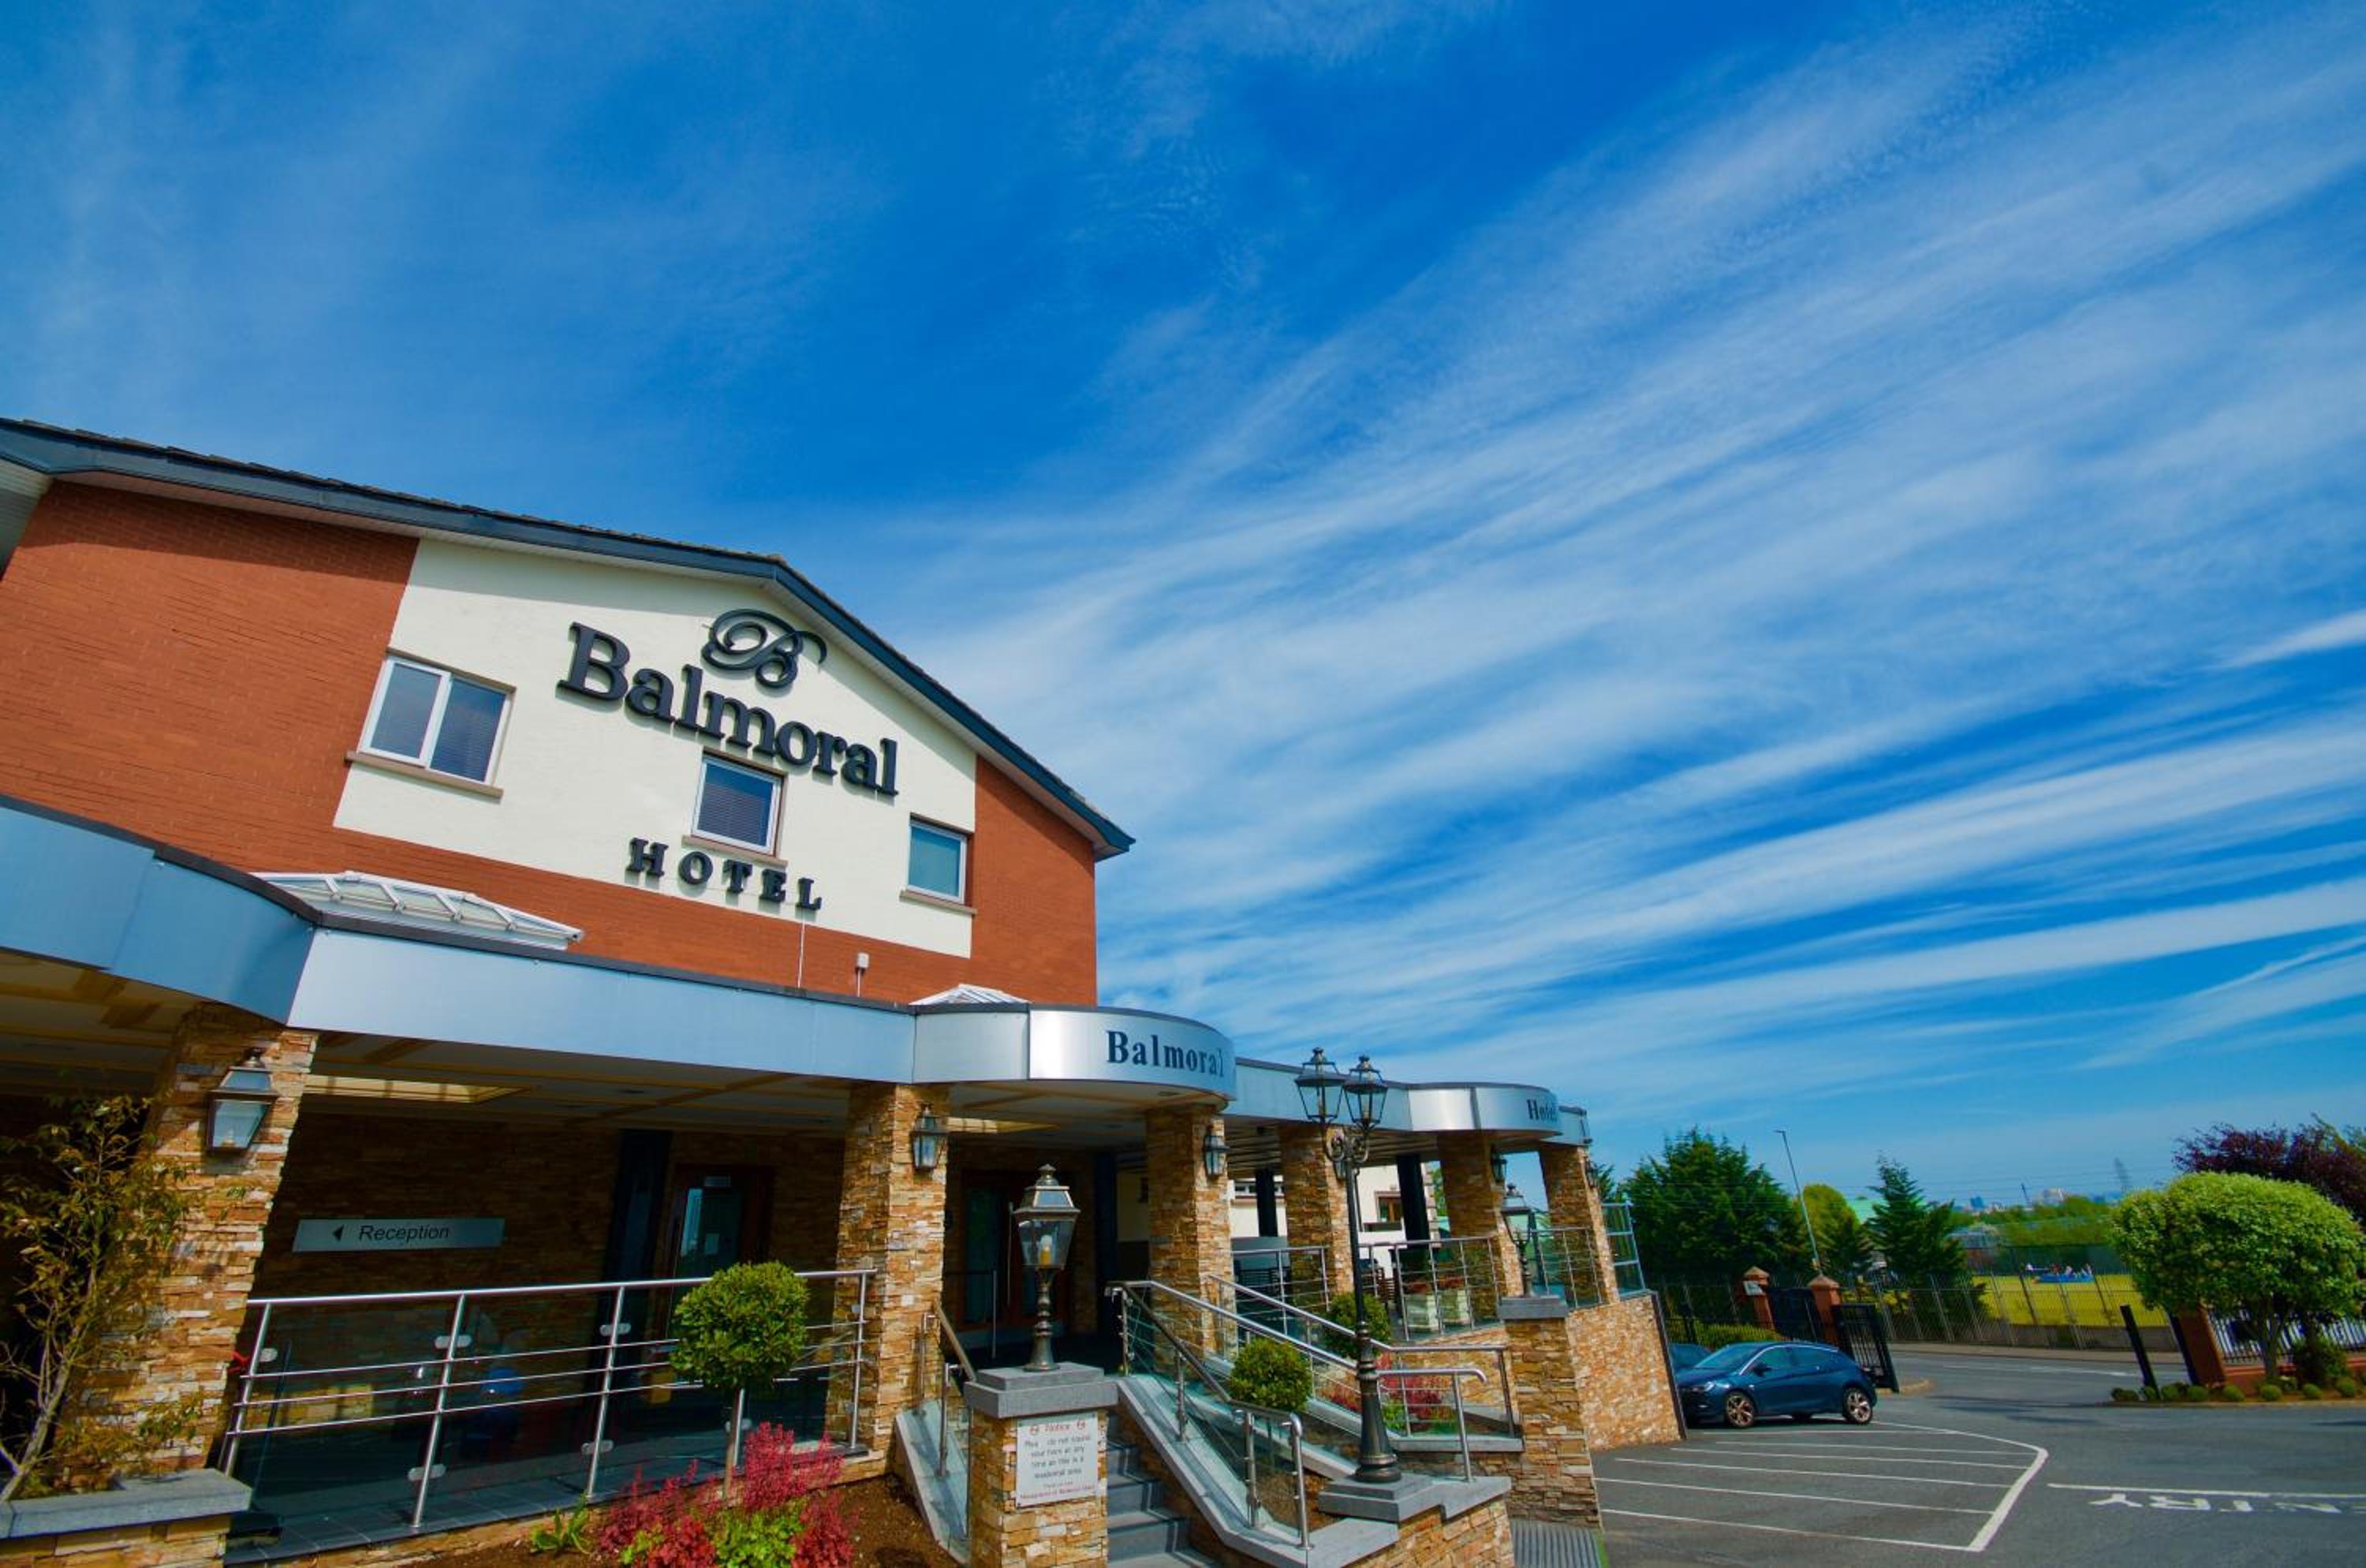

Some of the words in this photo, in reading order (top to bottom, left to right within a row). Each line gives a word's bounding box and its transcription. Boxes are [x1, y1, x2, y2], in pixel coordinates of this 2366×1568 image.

[556, 621, 899, 797] Balmoral
[626, 837, 822, 911] HOTEL
[1106, 1030, 1224, 1077] Balmoral
[359, 1225, 450, 1243] Reception
